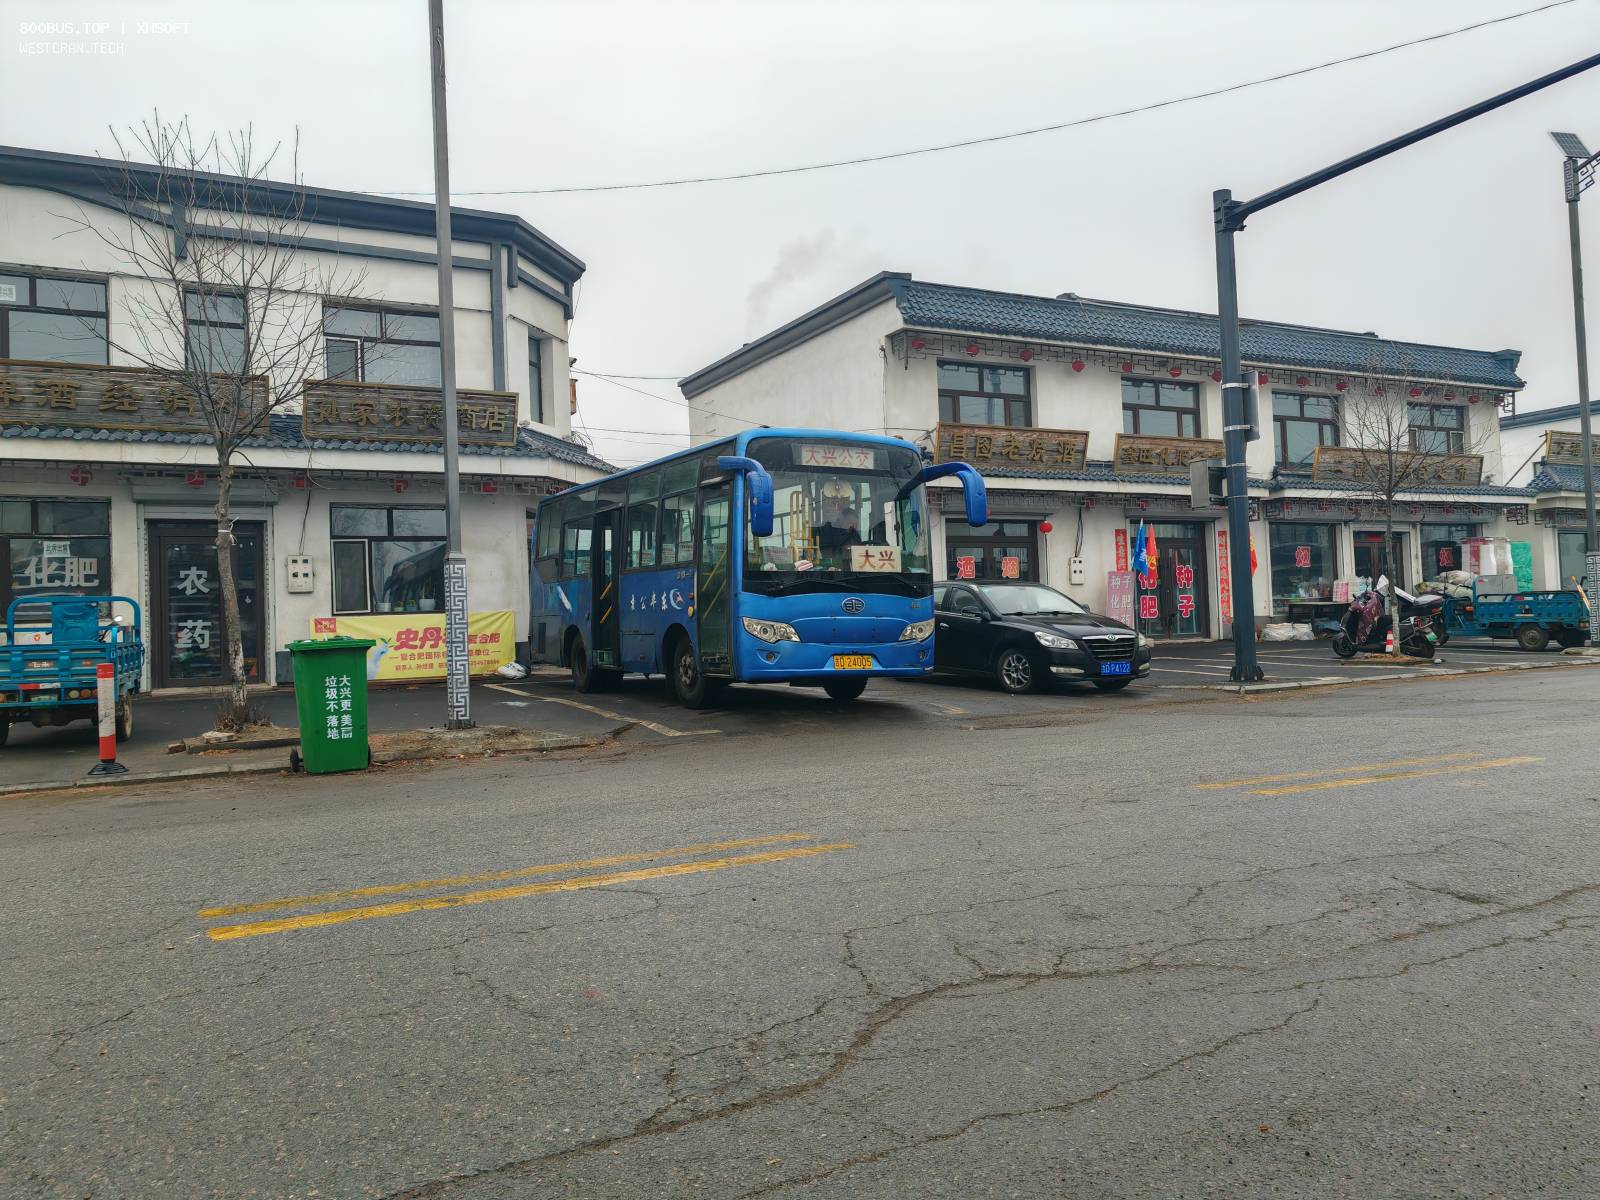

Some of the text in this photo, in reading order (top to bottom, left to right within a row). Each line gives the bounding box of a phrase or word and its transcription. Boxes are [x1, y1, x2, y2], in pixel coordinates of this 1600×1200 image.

[804, 446, 870, 468] 大兴公交
[24, 557, 99, 587] 化肥
[859, 550, 896, 569] 大兴
[956, 556, 975, 579] 酒
[177, 566, 212, 649] 农药
[1177, 565, 1195, 617] 种子
[325, 676, 340, 739] 垃圾不落地
[339, 675, 353, 739] 大兴更美丽
